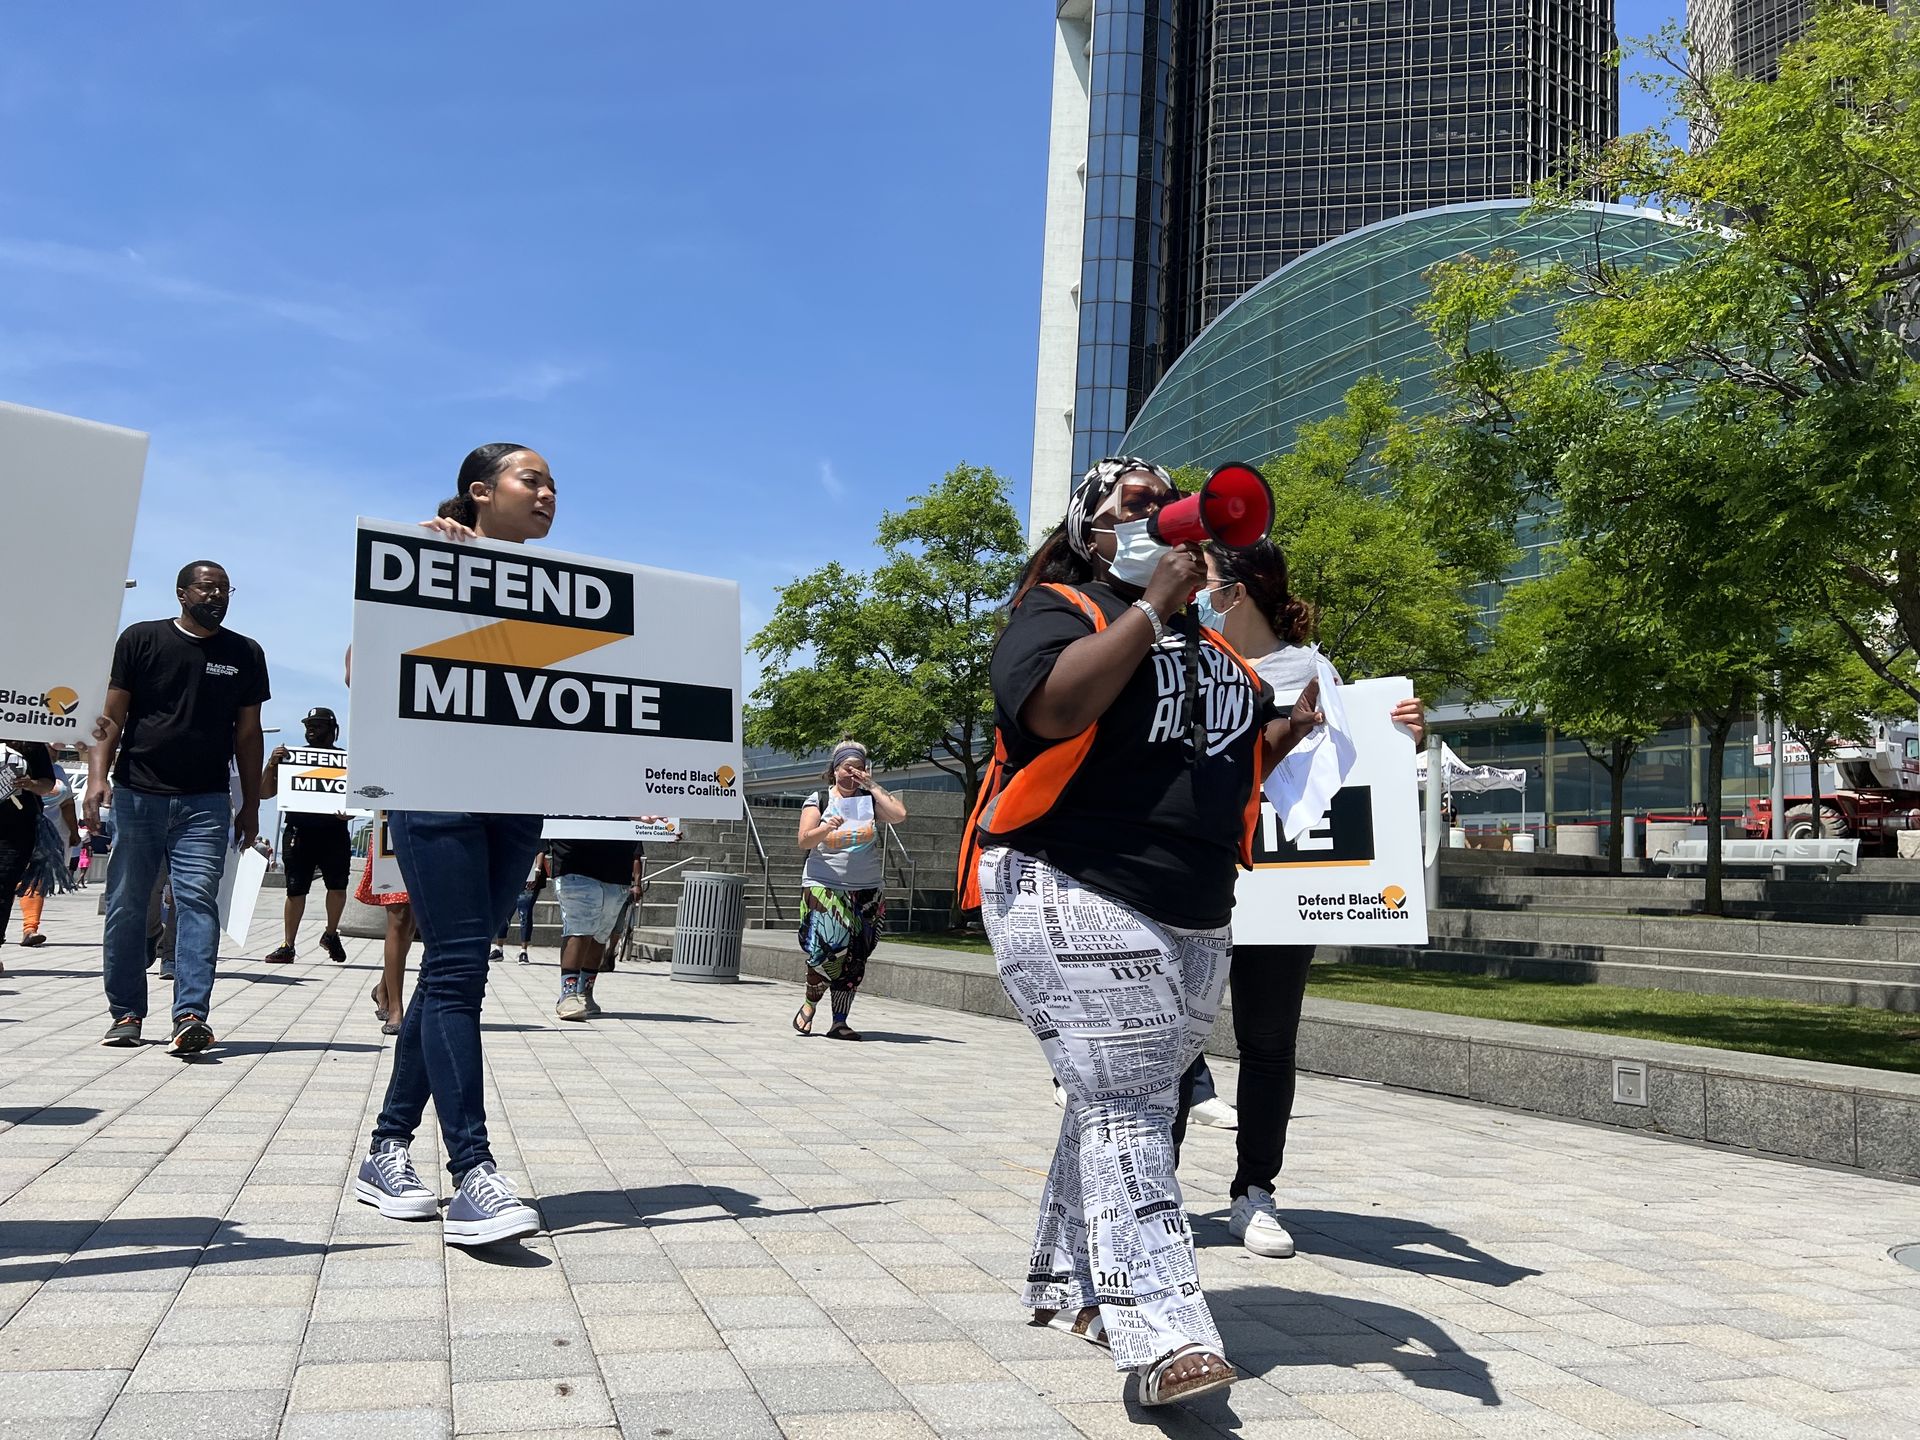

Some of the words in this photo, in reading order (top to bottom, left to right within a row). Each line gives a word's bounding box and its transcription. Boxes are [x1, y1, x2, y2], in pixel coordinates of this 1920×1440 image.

[369, 540, 612, 620] DEFEND
[413, 662, 487, 717] MI
[503, 671, 661, 731] VOTE
[645, 767, 687, 782] Defend
[690, 769, 721, 784] Black
[295, 778, 317, 791] MI
[321, 780, 346, 792] VO
[645, 782, 685, 796] Voters
[687, 784, 737, 798] Coalition
[1017, 857, 1039, 896] Dail
[1298, 894, 1345, 906] Defend
[1349, 892, 1387, 905] Black
[1043, 906, 1059, 924] WAR
[1298, 909, 1344, 921] Voters
[1347, 907, 1409, 920] Coalition
[1047, 926, 1069, 949] ENDS!
[1070, 933, 1123, 943] EXTRA!
[1074, 942, 1128, 951] EXTRA!
[1132, 957, 1164, 965] STREET
[1117, 1013, 1177, 1031] Daily
[1093, 1059, 1107, 1089] Breaking
[1094, 1088, 1135, 1100] ORLD
[1119, 1151, 1134, 1175] WAR
[1123, 1174, 1143, 1203] ENDS!
[1136, 1294, 1155, 1303] NEW
